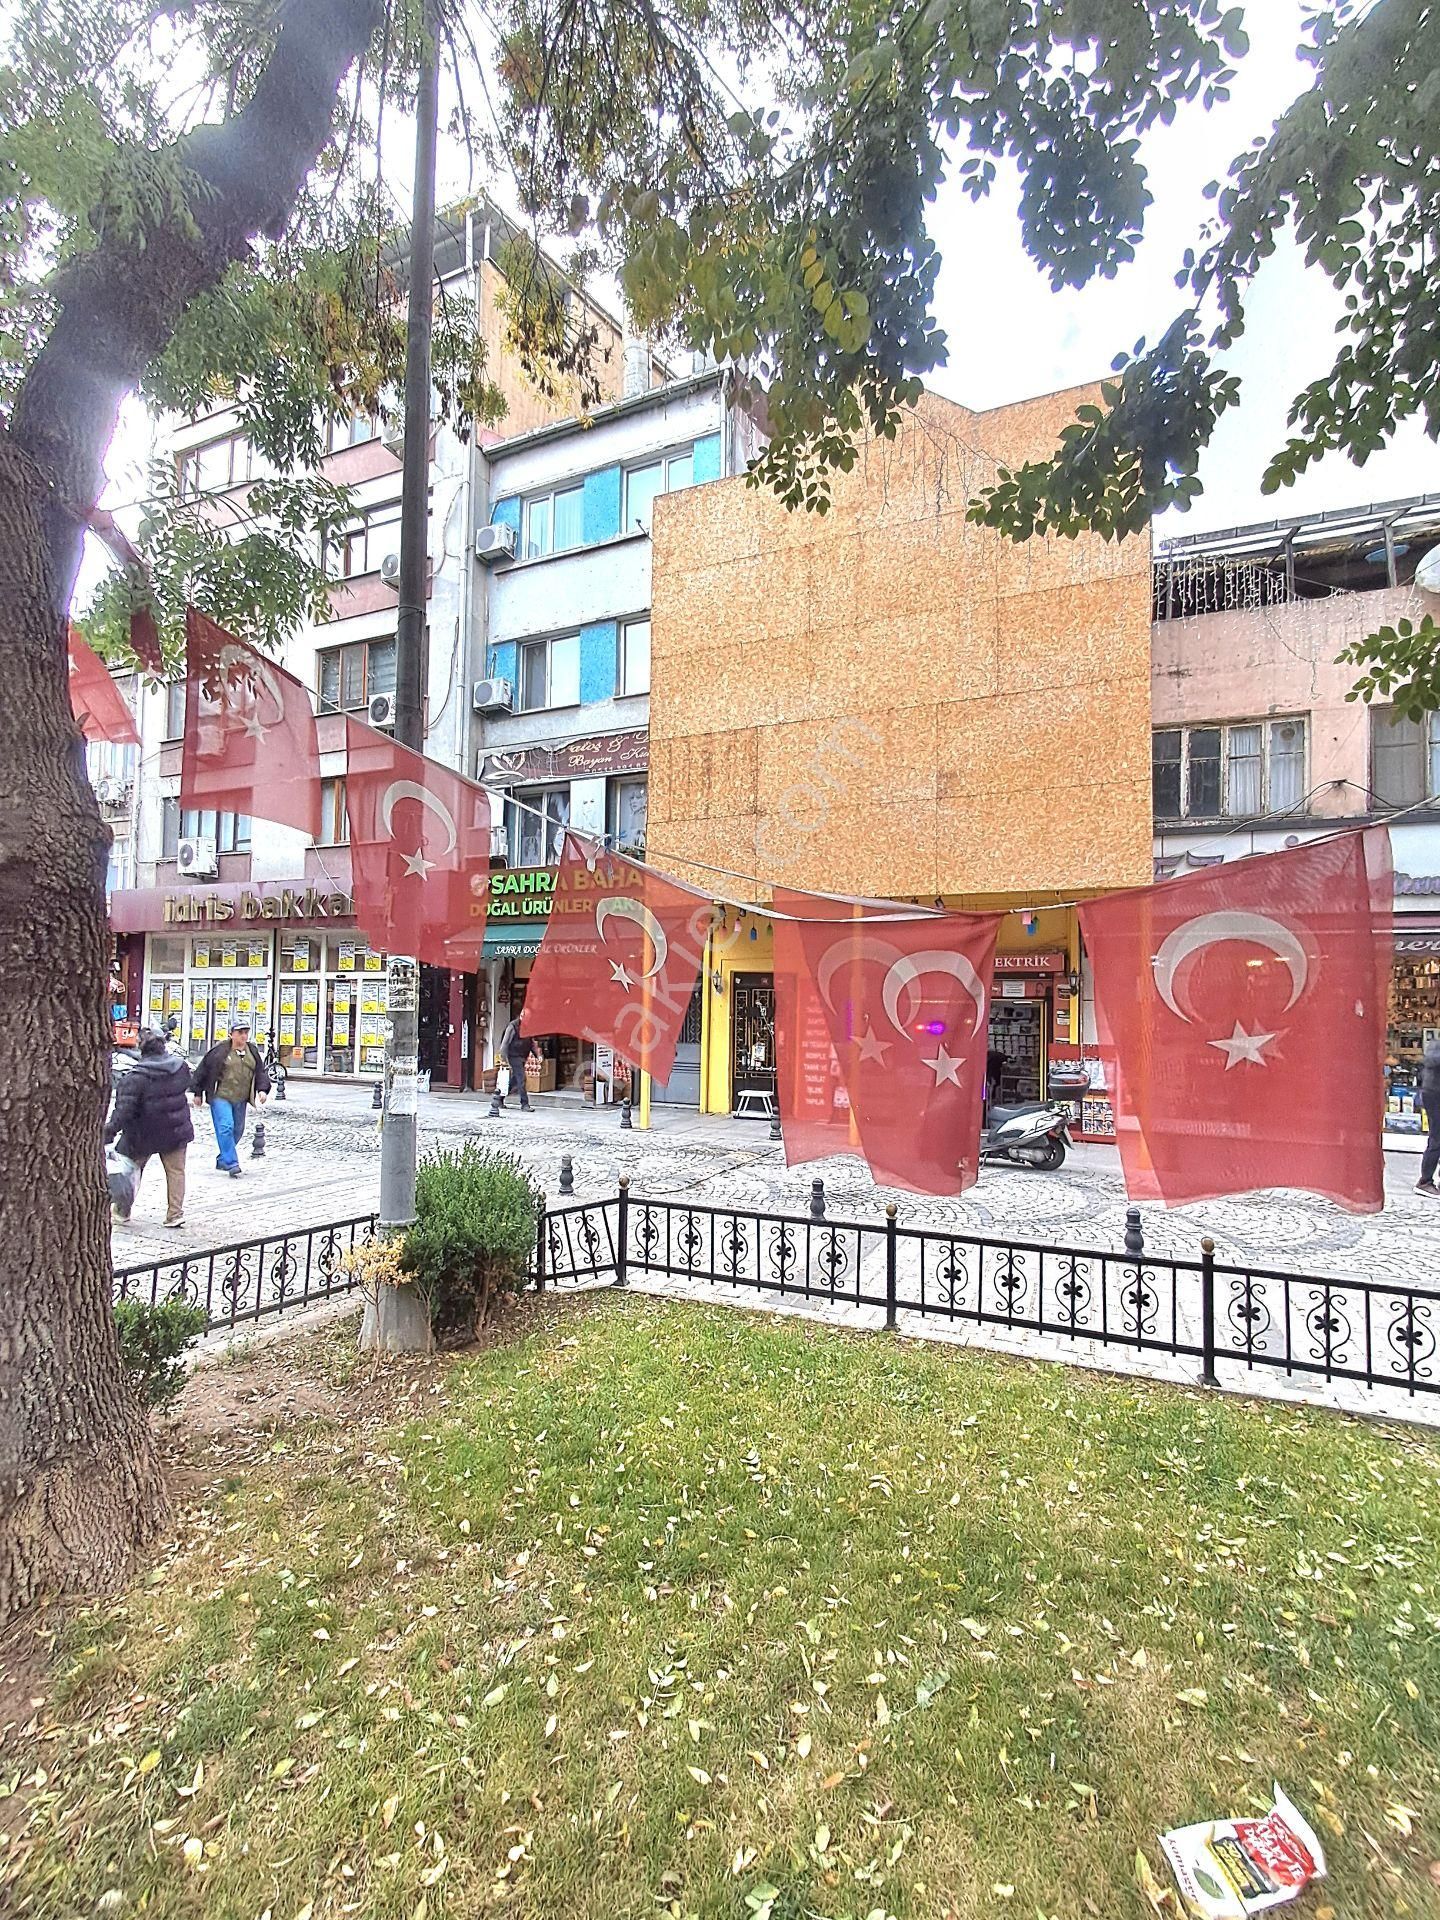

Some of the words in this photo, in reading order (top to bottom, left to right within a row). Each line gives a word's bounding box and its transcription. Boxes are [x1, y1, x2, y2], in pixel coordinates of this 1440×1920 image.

[568, 754, 613, 769] Bayan
[491, 872, 569, 895] SAHRA
[163, 892, 235, 922] idris
[470, 898, 520, 917] DOĞAL
[522, 897, 593, 916] ÜRÜNLER
